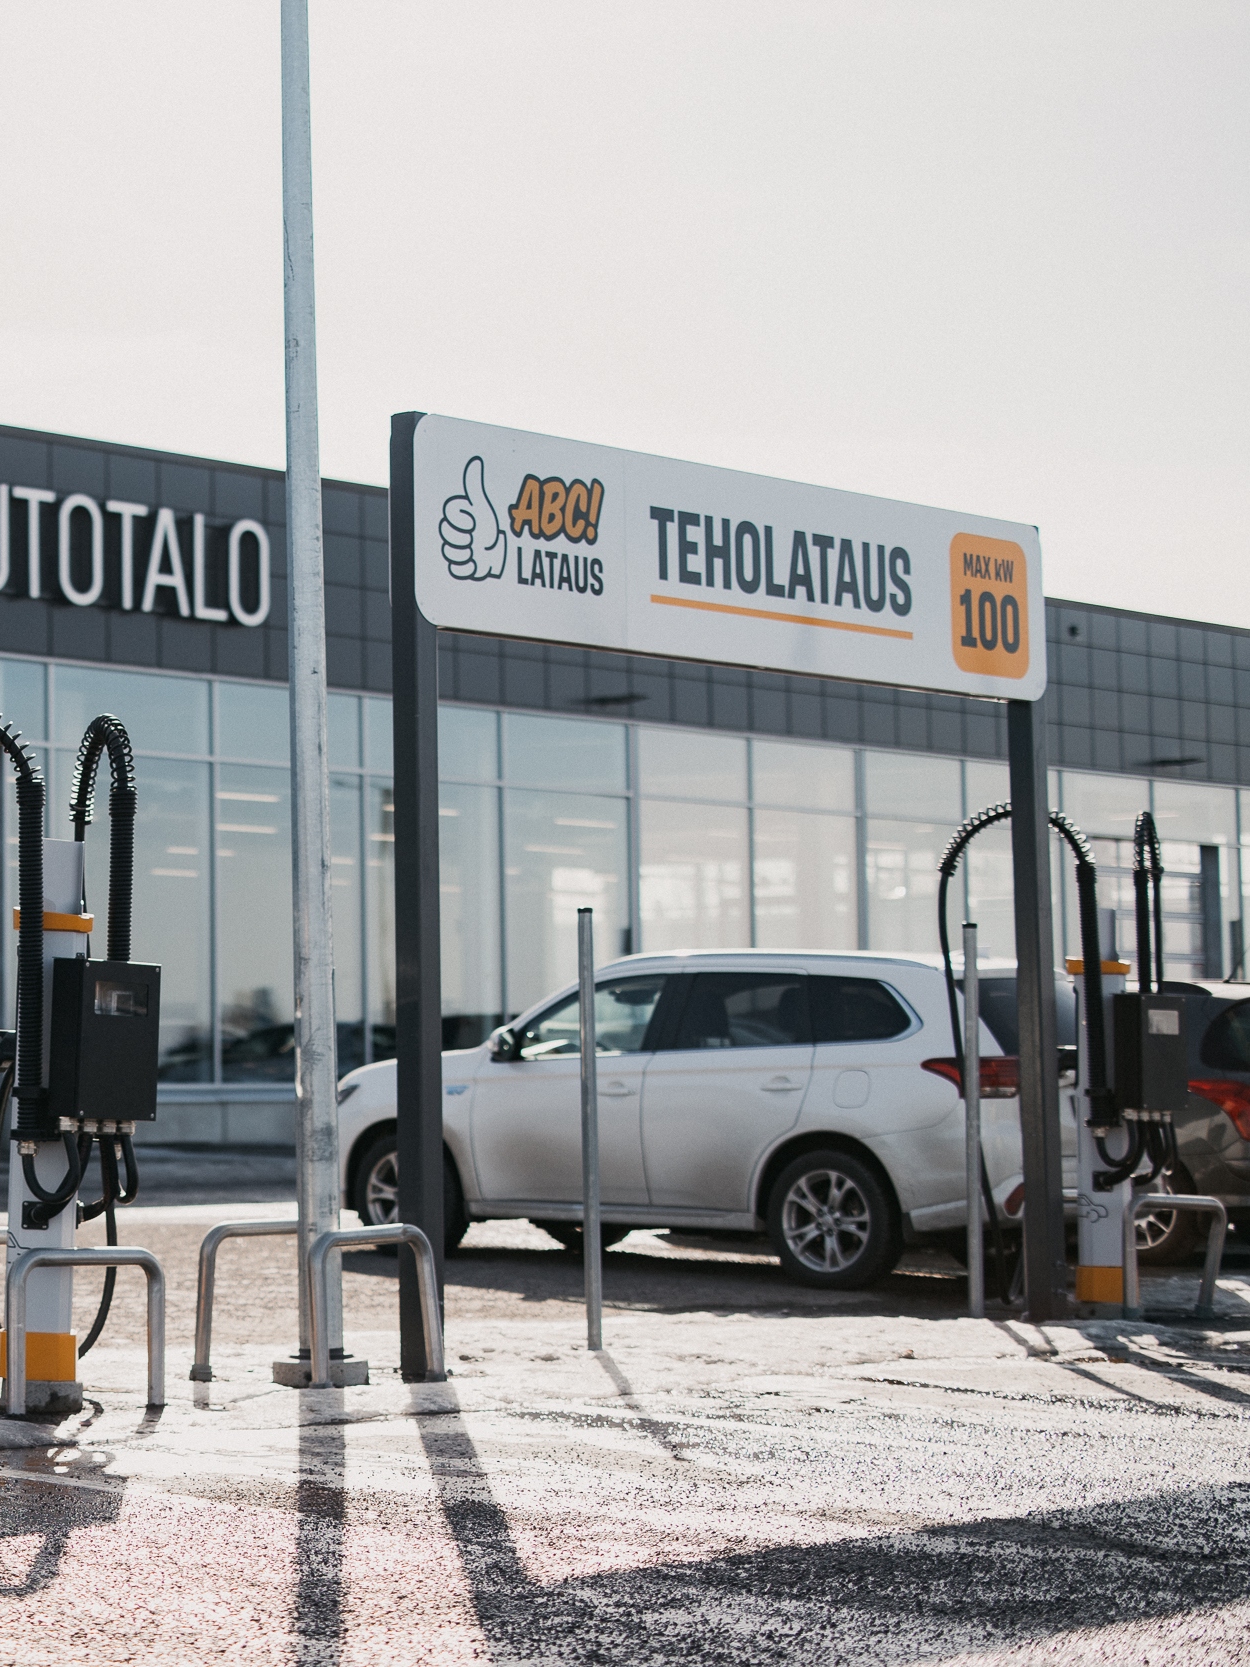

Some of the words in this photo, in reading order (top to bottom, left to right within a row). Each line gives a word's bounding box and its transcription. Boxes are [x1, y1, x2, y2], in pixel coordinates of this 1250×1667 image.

[508, 473, 605, 546] ABC!
[516, 546, 604, 596] LATAUS
[650, 505, 913, 617] TEHOLATAUS
[963, 552, 992, 581] MAX
[994, 558, 1014, 584] kW
[959, 588, 1021, 655] 100
